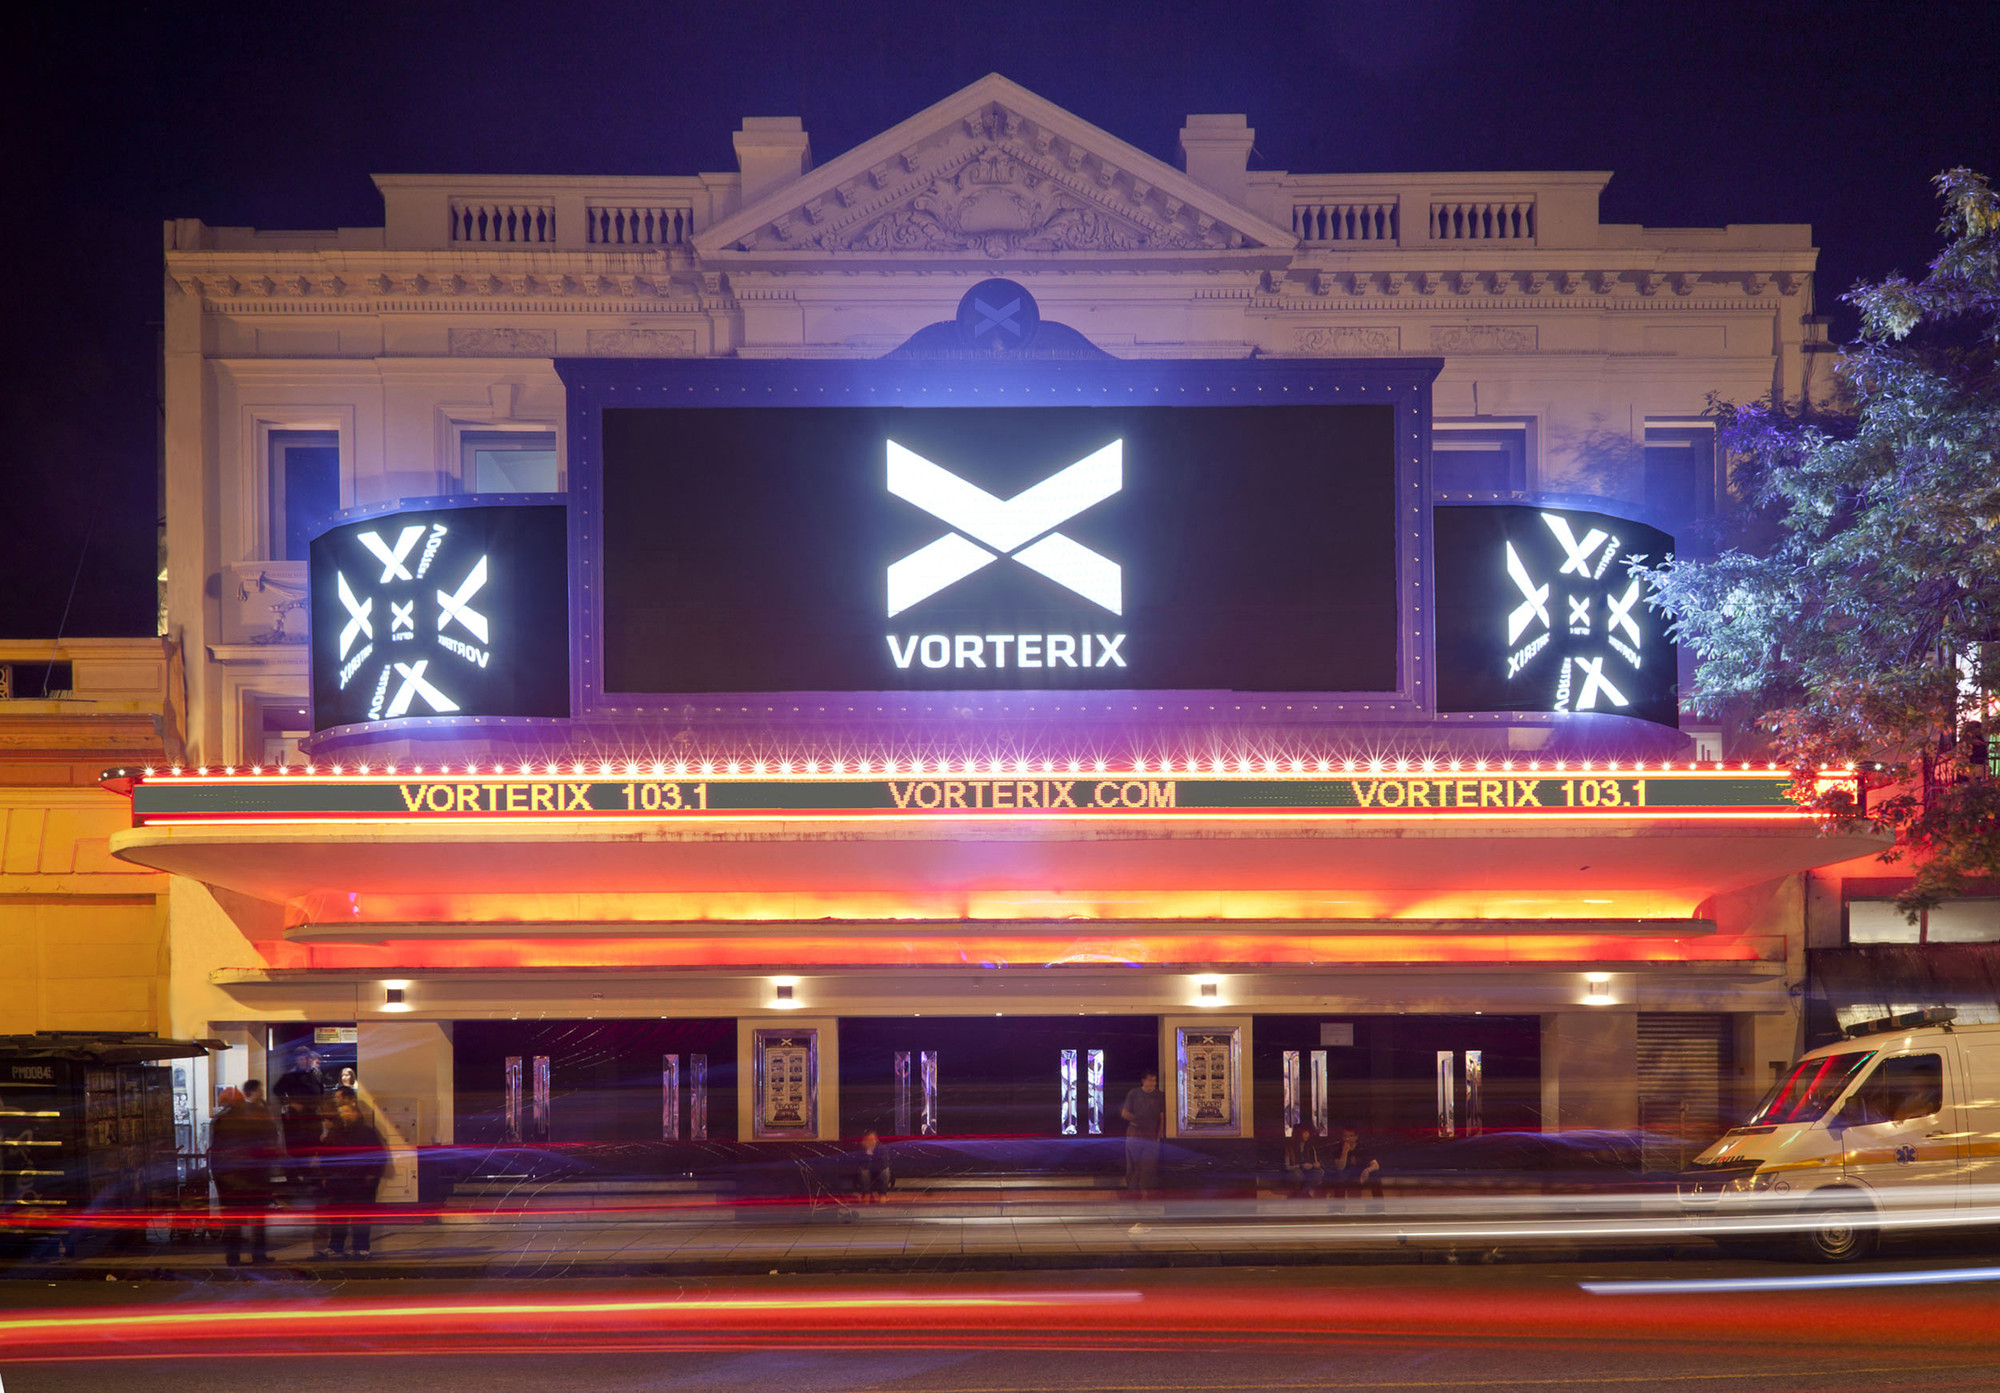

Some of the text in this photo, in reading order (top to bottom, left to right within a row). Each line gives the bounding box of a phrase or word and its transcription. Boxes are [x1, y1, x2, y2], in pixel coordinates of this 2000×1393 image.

[886, 634, 1127, 668] VORTERIX
[400, 783, 707, 812] VORTERIX 103.1
[888, 781, 1176, 808] VORTERIX.COM
[1351, 780, 1647, 807] VORTERIX 103.1
